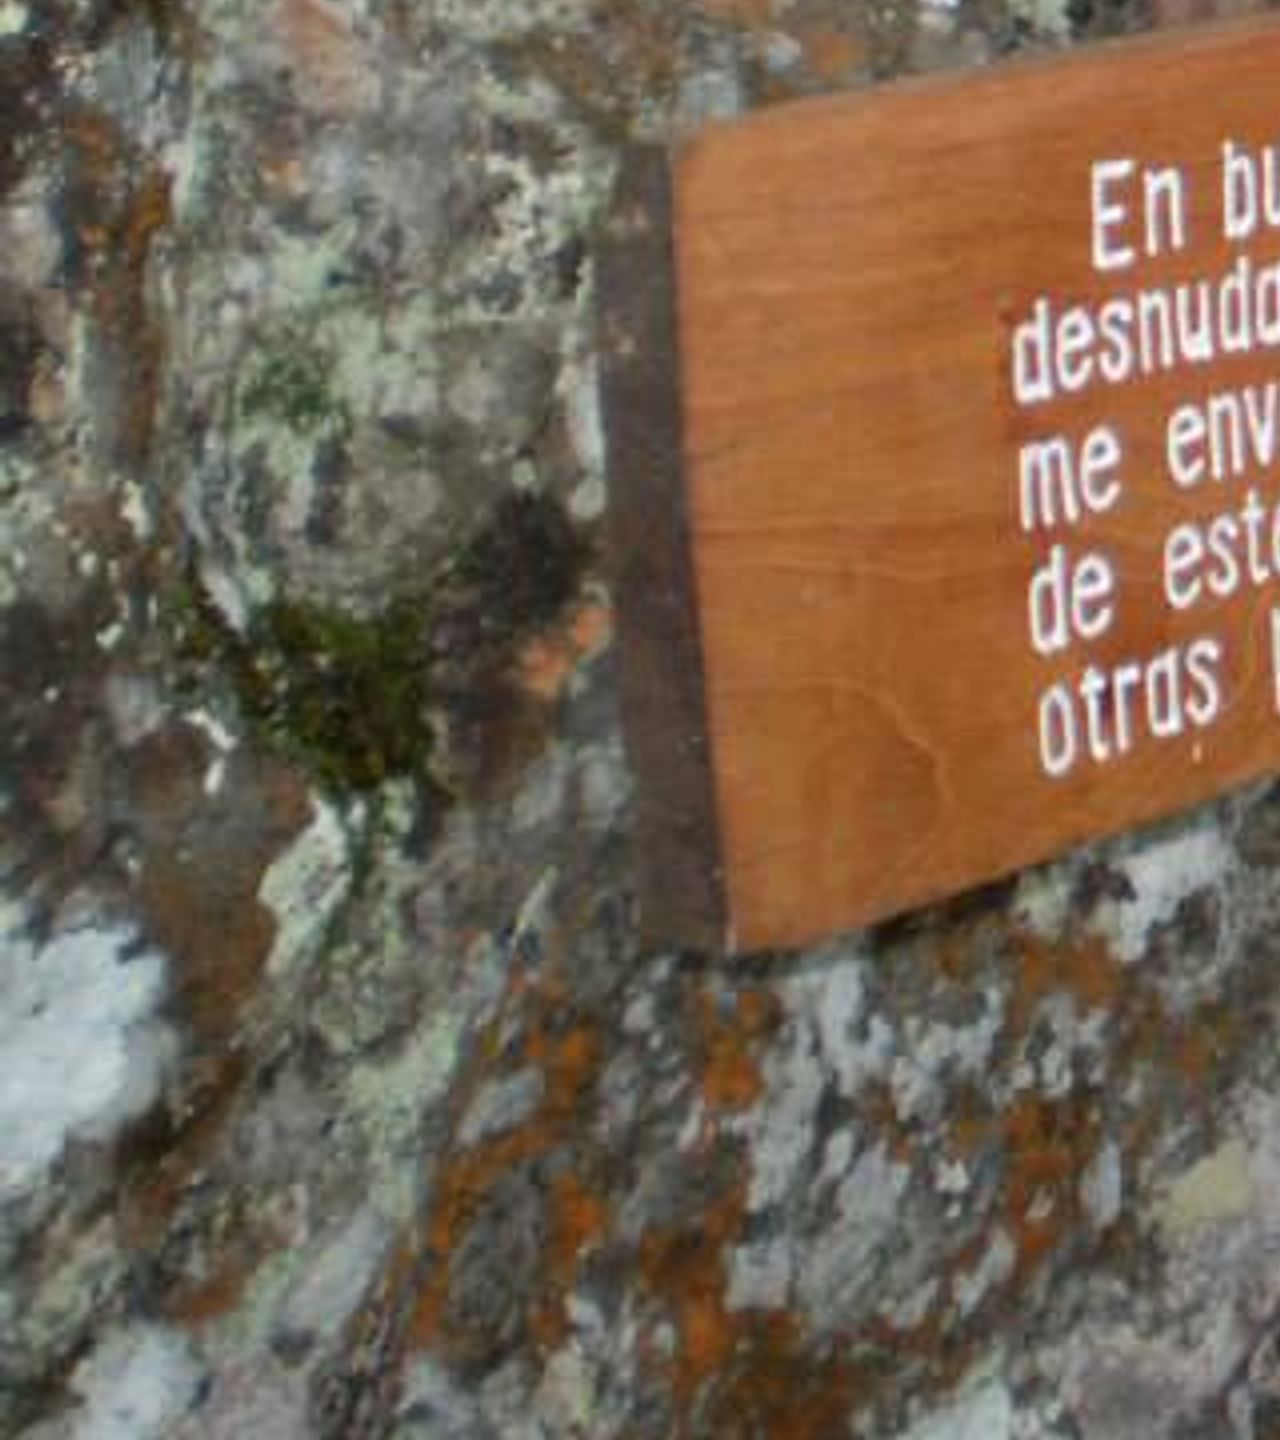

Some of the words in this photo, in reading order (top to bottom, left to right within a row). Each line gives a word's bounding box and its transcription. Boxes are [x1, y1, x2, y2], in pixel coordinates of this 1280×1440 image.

[1091, 159, 1185, 270] En
[1019, 426, 1122, 531] me
[1027, 544, 1115, 655] de
[1037, 635, 1223, 777] otras
